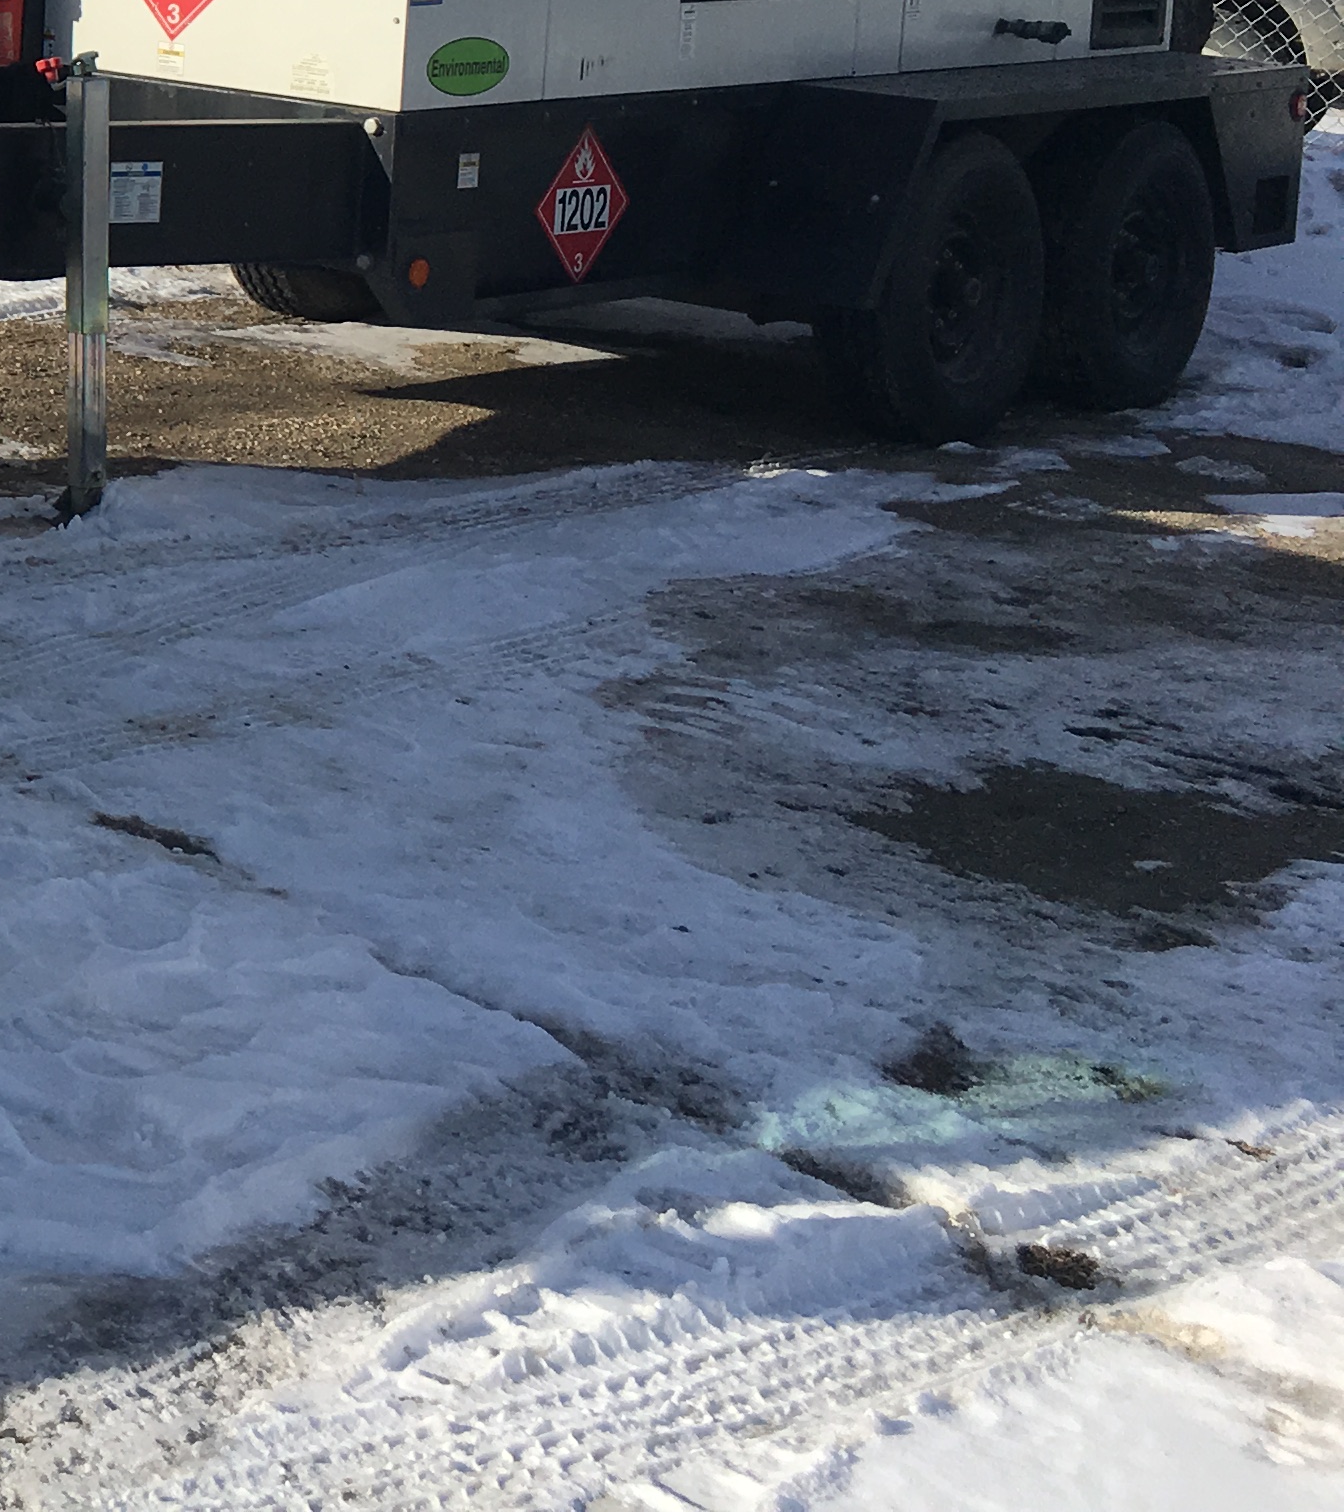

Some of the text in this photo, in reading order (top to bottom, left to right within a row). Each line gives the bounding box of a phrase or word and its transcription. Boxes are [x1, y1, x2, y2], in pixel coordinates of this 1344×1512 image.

[166, 3, 181, 24] 3
[430, 55, 506, 78] Environmental
[558, 186, 608, 233] 1202
[573, 252, 584, 273] 3
